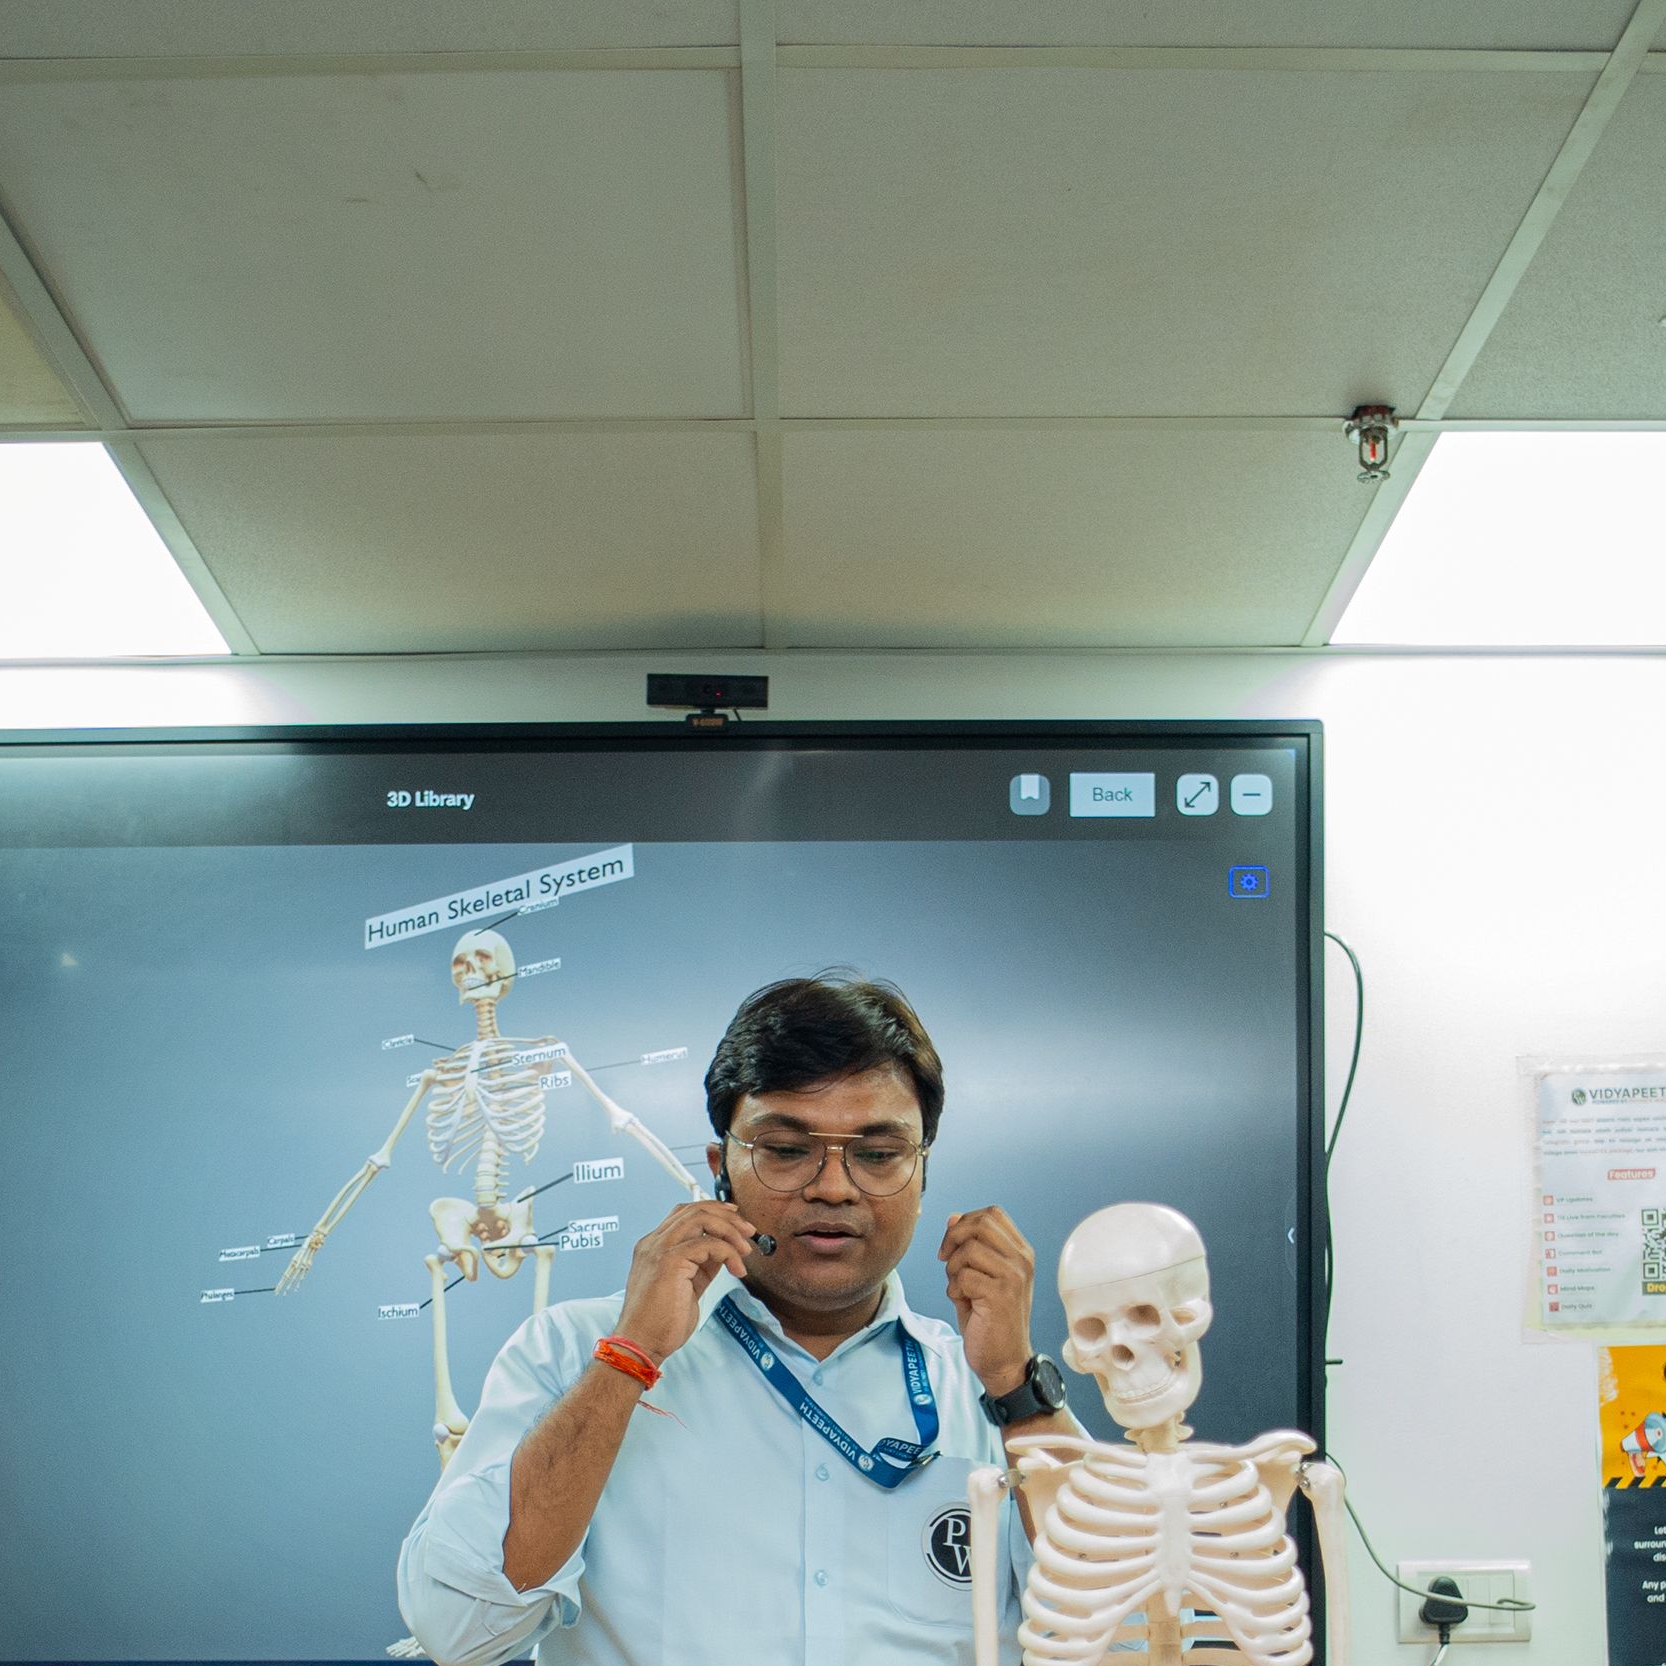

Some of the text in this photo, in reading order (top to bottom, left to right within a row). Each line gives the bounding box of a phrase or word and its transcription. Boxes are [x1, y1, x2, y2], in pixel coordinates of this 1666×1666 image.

[387, 791, 474, 810] 3D Library
[1092, 787, 1133, 802] Back
[368, 859, 624, 942] Human Skeletal System
[519, 960, 559, 977] Mandible
[513, 1048, 565, 1065] Sternum
[541, 1076, 569, 1089] Ribs
[576, 1165, 621, 1182] Ilium
[1609, 1170, 1654, 1180] Features
[569, 1219, 618, 1232] Sacrum
[561, 1233, 601, 1249] Pubis
[378, 1307, 418, 1318] Ischium
[799, 1401, 856, 1462] VIDYAPEETH
[1643, 1581, 1658, 1591] Any
[1647, 1594, 1664, 1603] and
